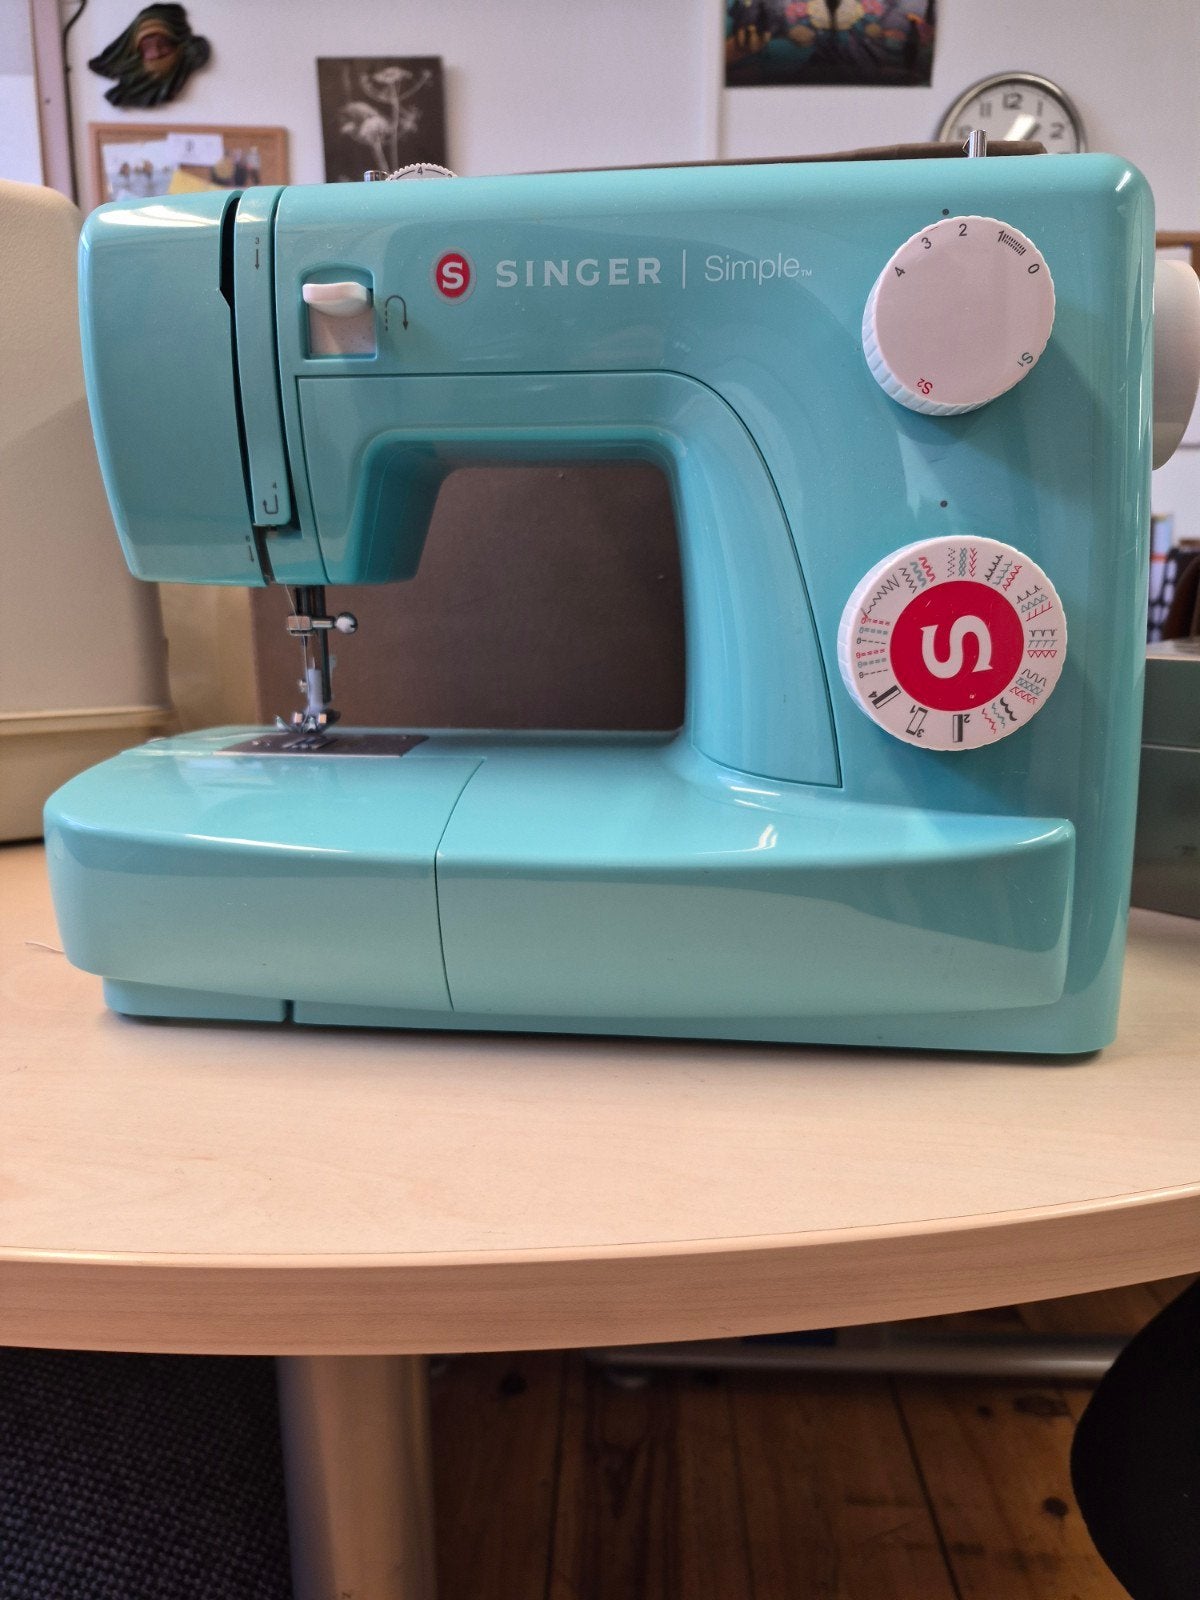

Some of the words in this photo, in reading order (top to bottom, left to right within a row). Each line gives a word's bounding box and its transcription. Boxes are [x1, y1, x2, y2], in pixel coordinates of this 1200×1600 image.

[1003, 92, 1022, 110] 12
[1051, 122, 1064, 139] 2
[417, 166, 423, 175] 4
[958, 223, 968, 236] 2
[255, 236, 260, 244] 3
[998, 230, 1004, 242] 1
[921, 237, 932, 249] 3
[496, 257, 662, 288] SINGER
[704, 252, 800, 286] Simple
[894, 265, 906, 277] 4
[1027, 263, 1040, 275] 0
[440, 262, 464, 290] S
[868, 690, 878, 698] 4
[910, 704, 916, 714] 1
[963, 713, 971, 724] 2
[916, 728, 925, 738] 3
